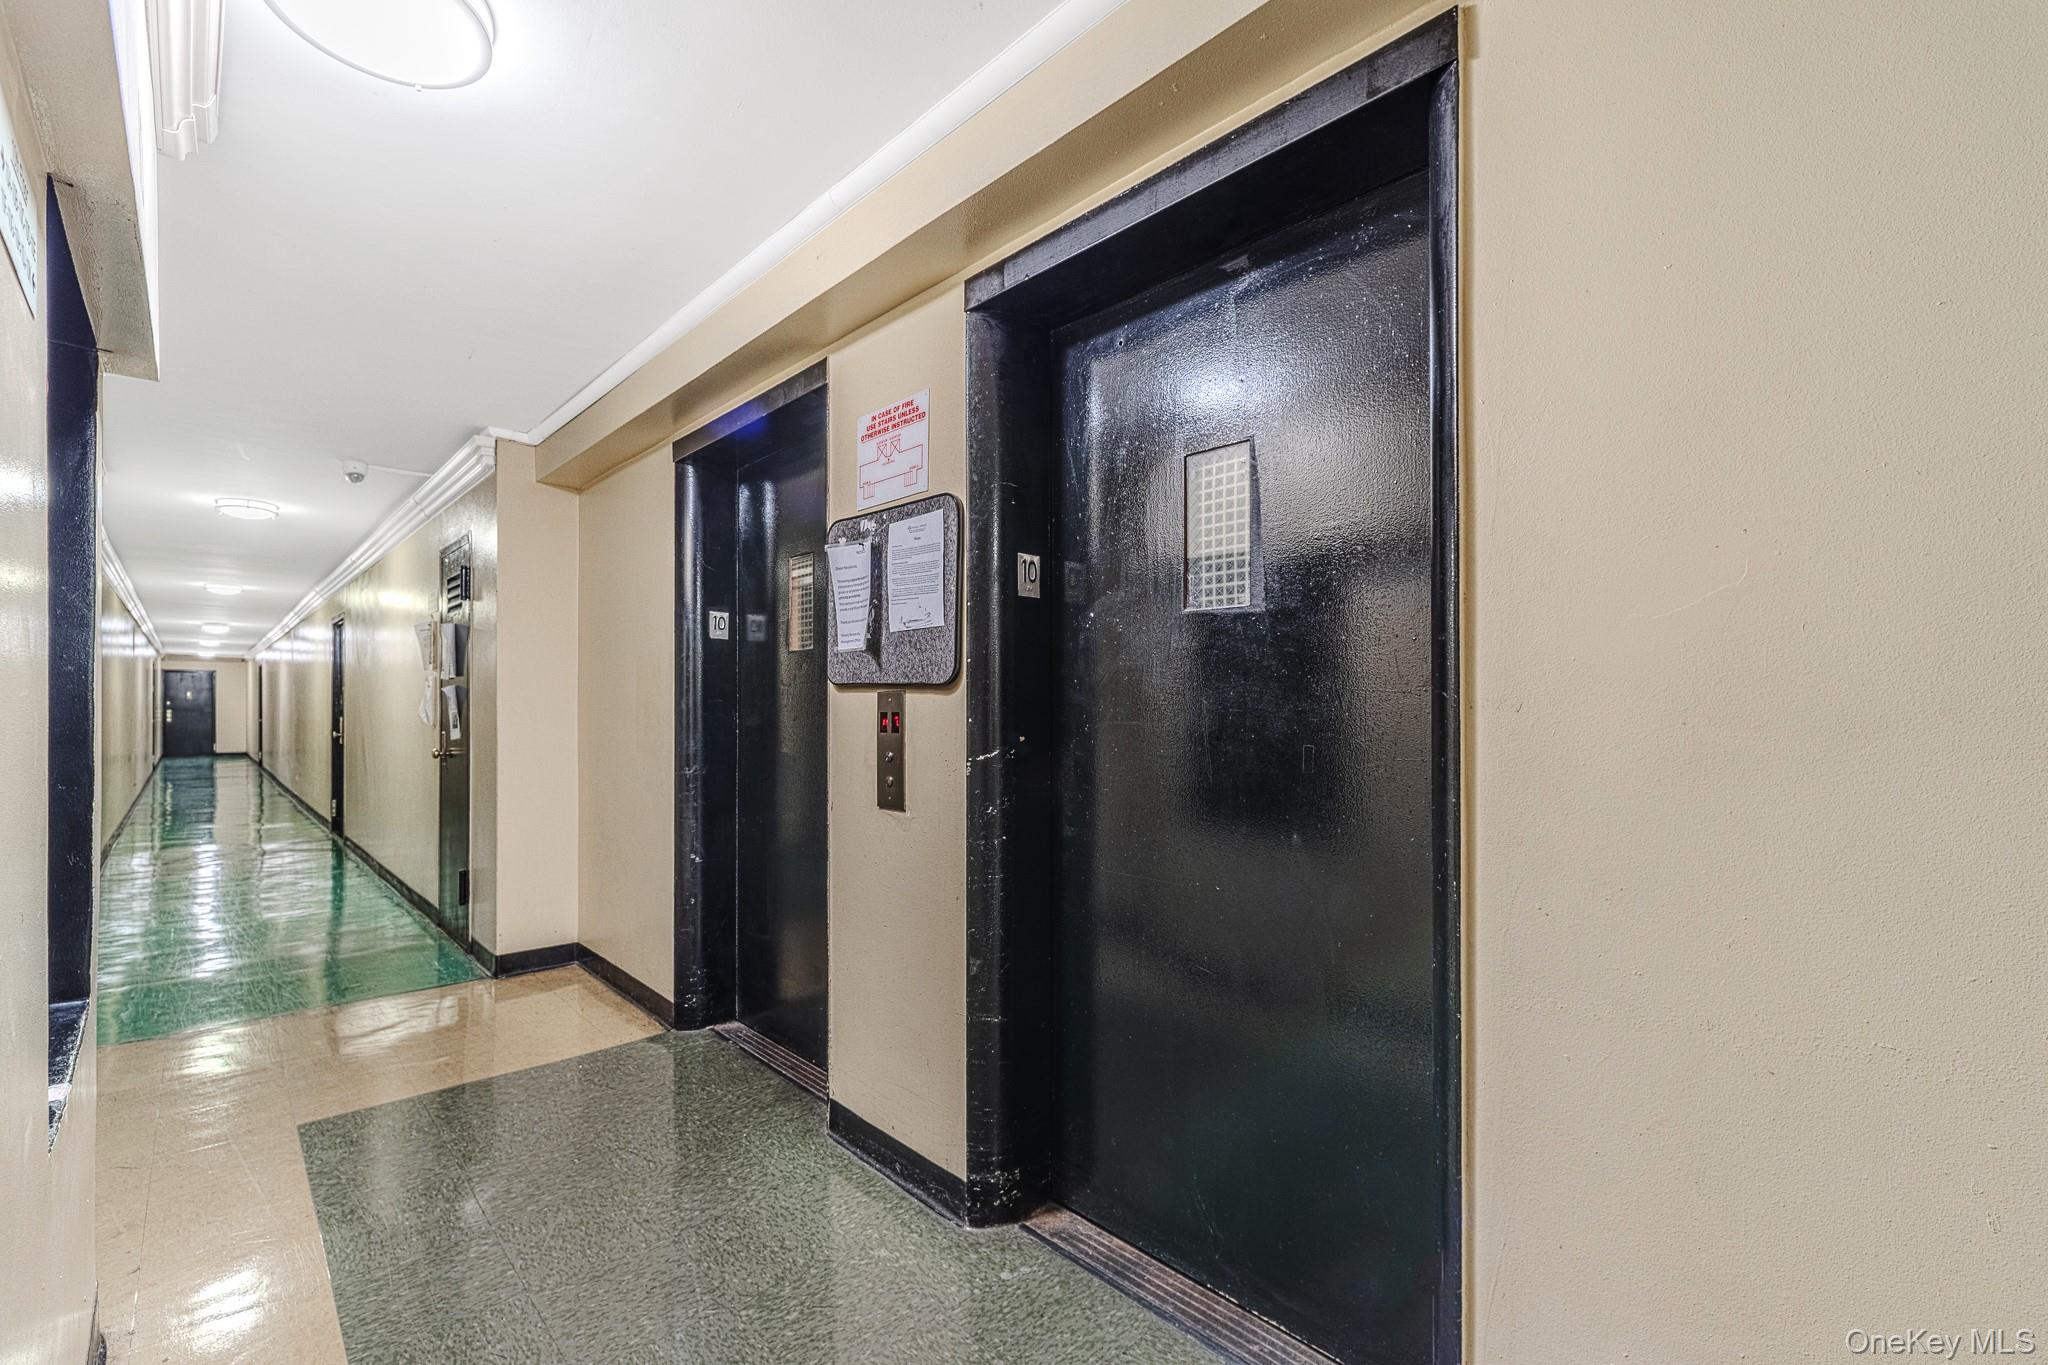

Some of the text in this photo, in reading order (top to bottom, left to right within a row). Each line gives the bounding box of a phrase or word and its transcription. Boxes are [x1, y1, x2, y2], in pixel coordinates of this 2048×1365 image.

[866, 405, 919, 432] USE STAIRS UNLESS
[871, 399, 914, 422] IN CASE OF FIRE
[860, 411, 926, 442] OTHERWISE INSTRUCTED
[1022, 558, 1037, 583] 10
[712, 615, 726, 629] 10
